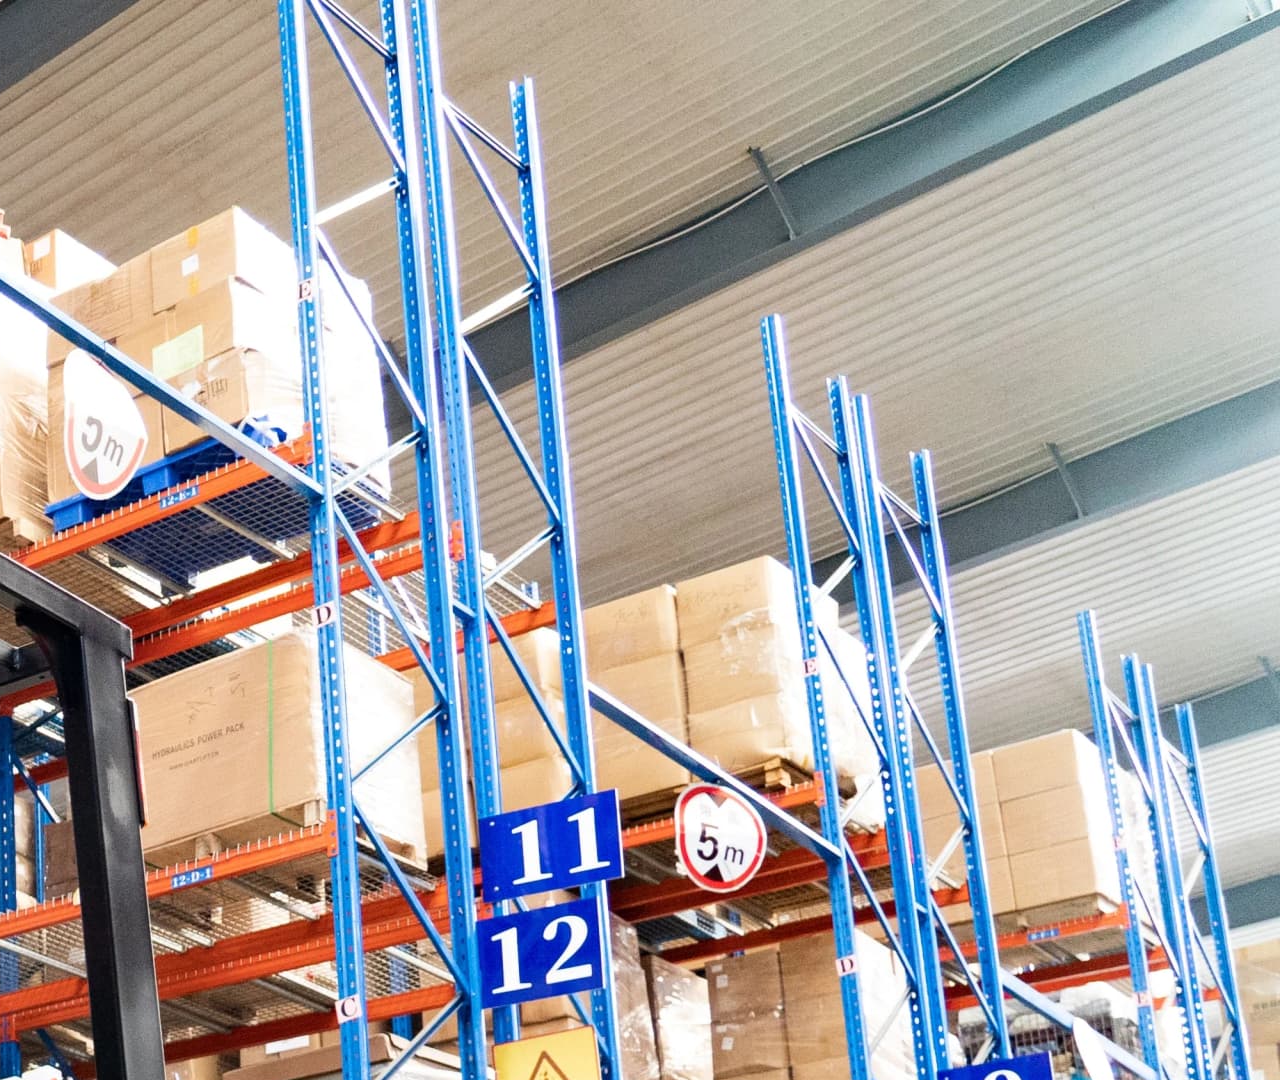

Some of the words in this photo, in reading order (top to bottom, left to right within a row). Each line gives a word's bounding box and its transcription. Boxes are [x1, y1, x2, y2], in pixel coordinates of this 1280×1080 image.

[316, 606, 331, 625] D
[225, 722, 245, 736] PACK
[511, 807, 611, 885] 11
[173, 866, 212, 888] 12-D-1
[490, 915, 593, 995] 12
[839, 957, 854, 974] D
[340, 997, 358, 1017] C
